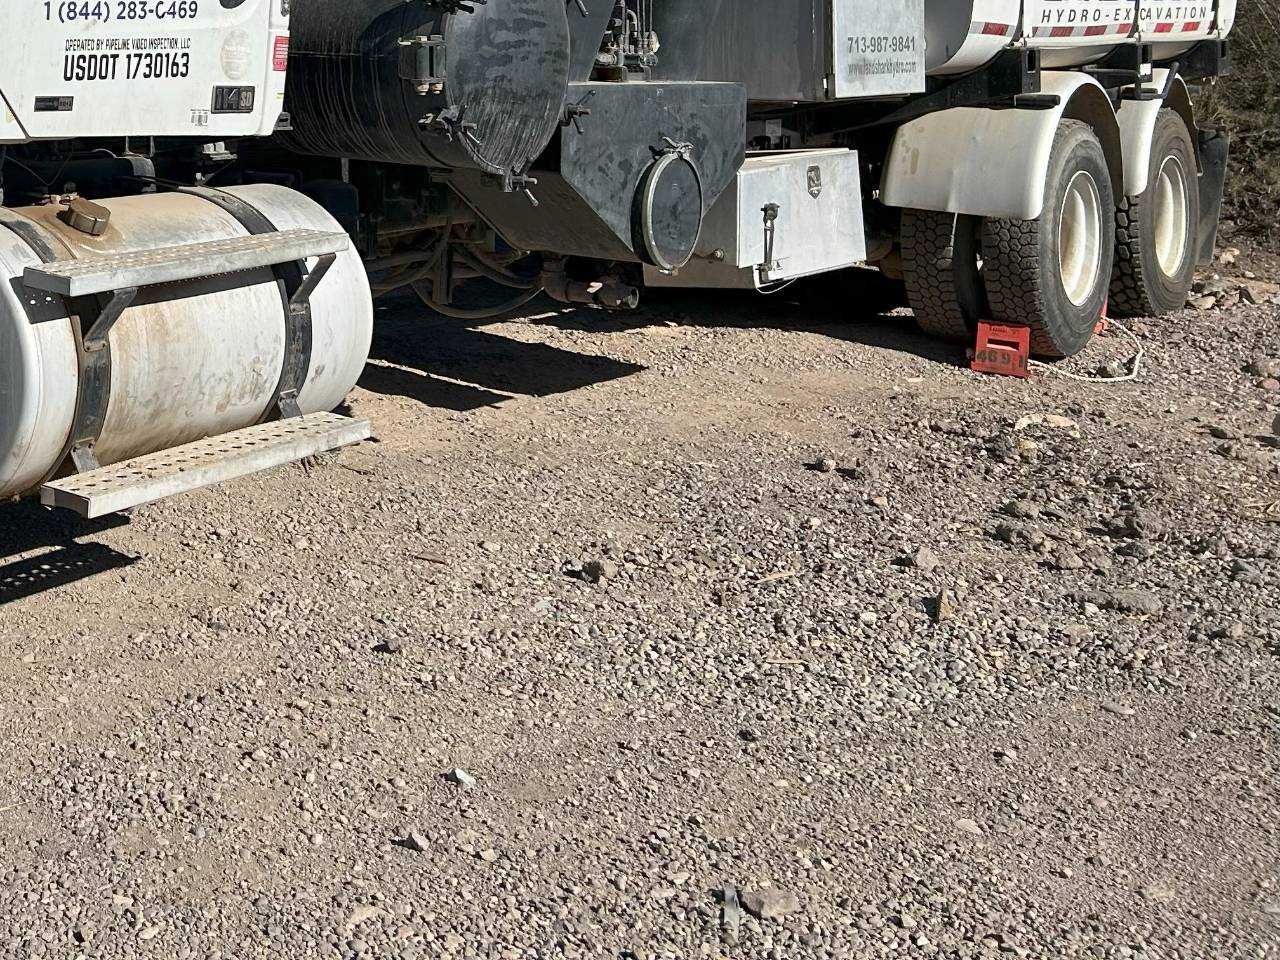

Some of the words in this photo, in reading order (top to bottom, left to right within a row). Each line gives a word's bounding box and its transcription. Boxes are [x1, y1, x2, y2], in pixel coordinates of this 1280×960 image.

[44, 1, 50, 20] 1
[58, 0, 110, 23] (844)
[1041, 6, 1207, 23] HYDRO-EXCAVATION
[65, 39, 95, 51] OPERATED
[96, 39, 104, 51] BY
[105, 38, 130, 50] PIPELINE
[131, 38, 148, 50] VIDEO
[180, 37, 191, 49] LLC
[847, 36, 915, 53] 713-987-9841
[64, 53, 119, 81] USDOT
[125, 52, 190, 79] 1730163
